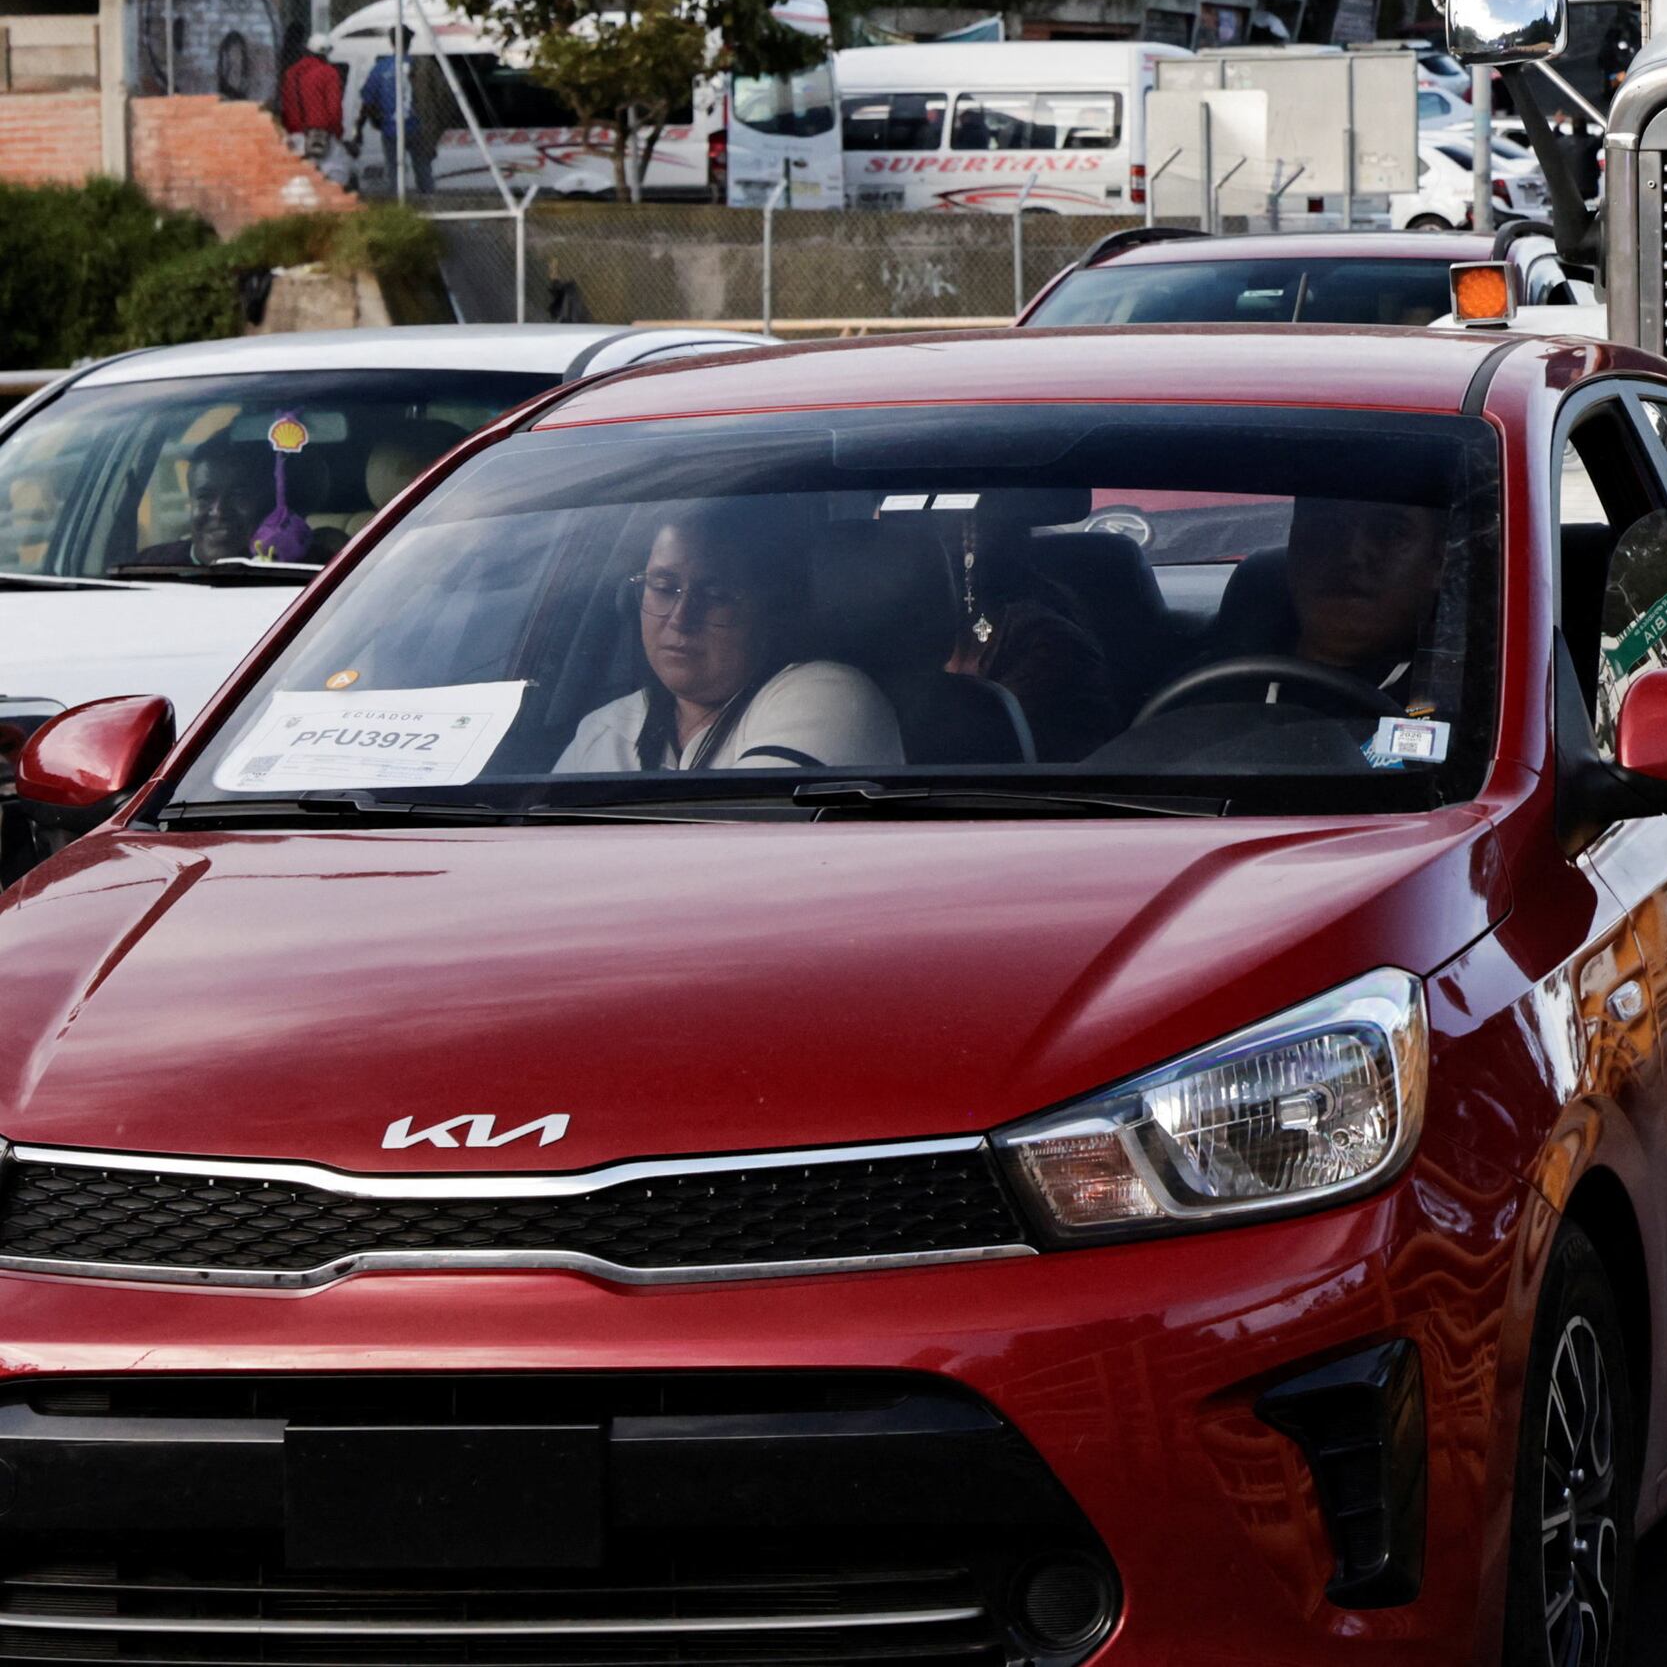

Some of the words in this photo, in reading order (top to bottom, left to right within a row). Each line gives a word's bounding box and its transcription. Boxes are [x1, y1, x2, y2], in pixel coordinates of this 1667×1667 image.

[864, 155, 1103, 174] SUPERTAXIS
[341, 711, 424, 721] ECUADOR
[290, 728, 440, 751] PFU3972
